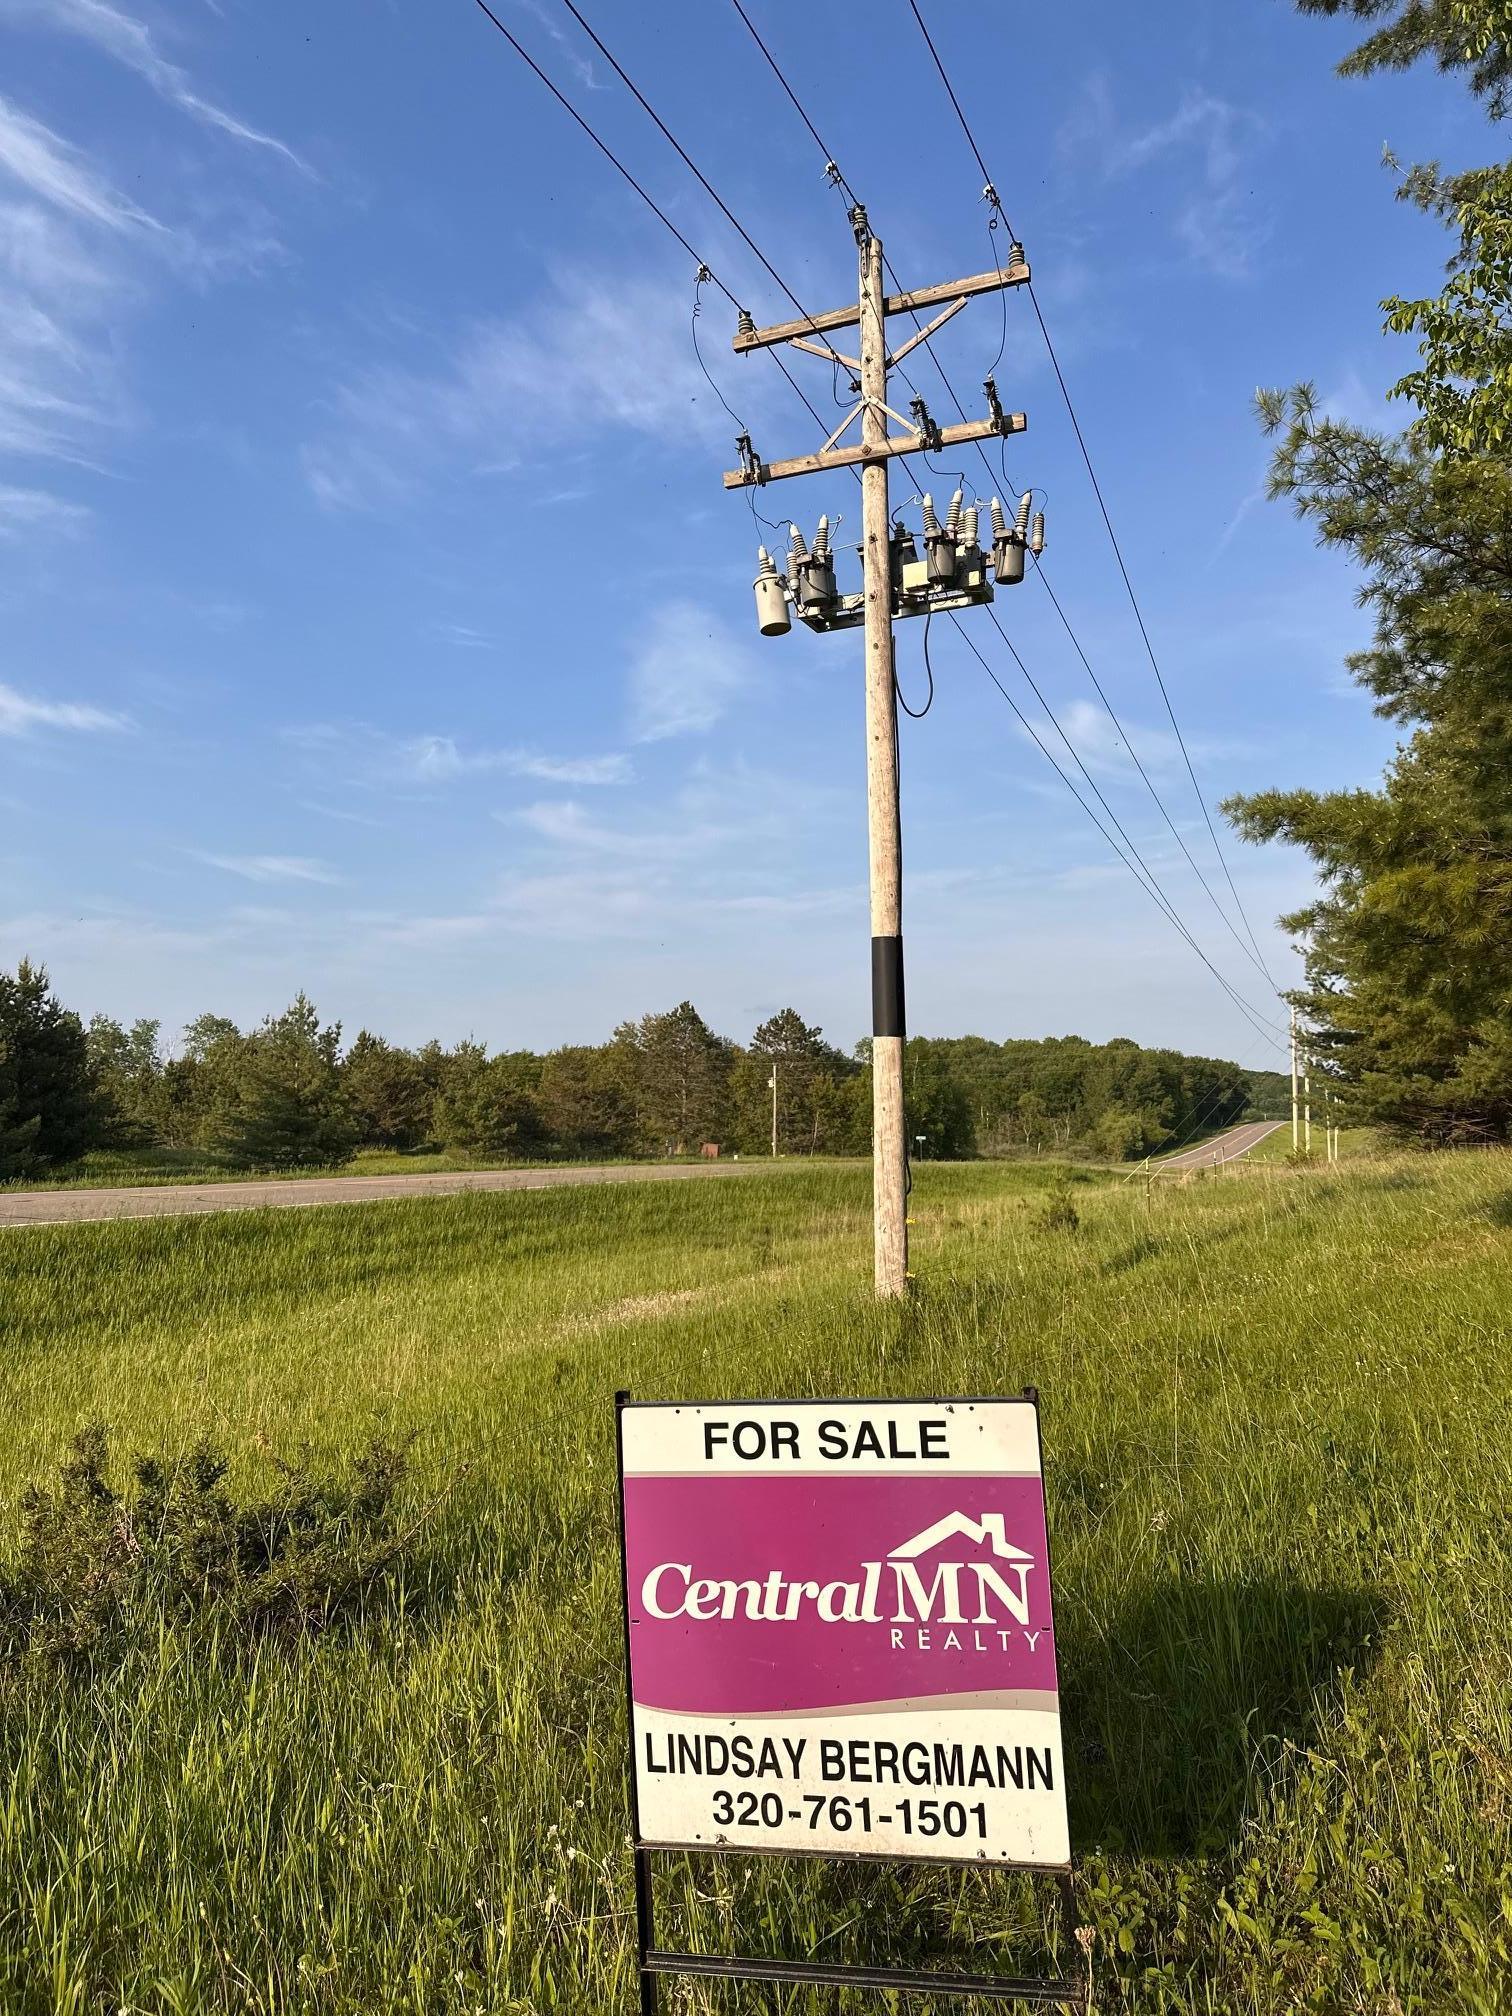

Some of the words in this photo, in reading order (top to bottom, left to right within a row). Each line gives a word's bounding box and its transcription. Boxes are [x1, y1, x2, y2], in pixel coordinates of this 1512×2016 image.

[703, 1421, 802, 1460] FOR
[818, 1420, 951, 1459] SALE
[891, 1628, 1041, 1653] REALTY
[645, 1733, 807, 1781] LINDSAY
[822, 1739, 1055, 1791] BERGMANN
[713, 1790, 988, 1839] 320-761-1501
